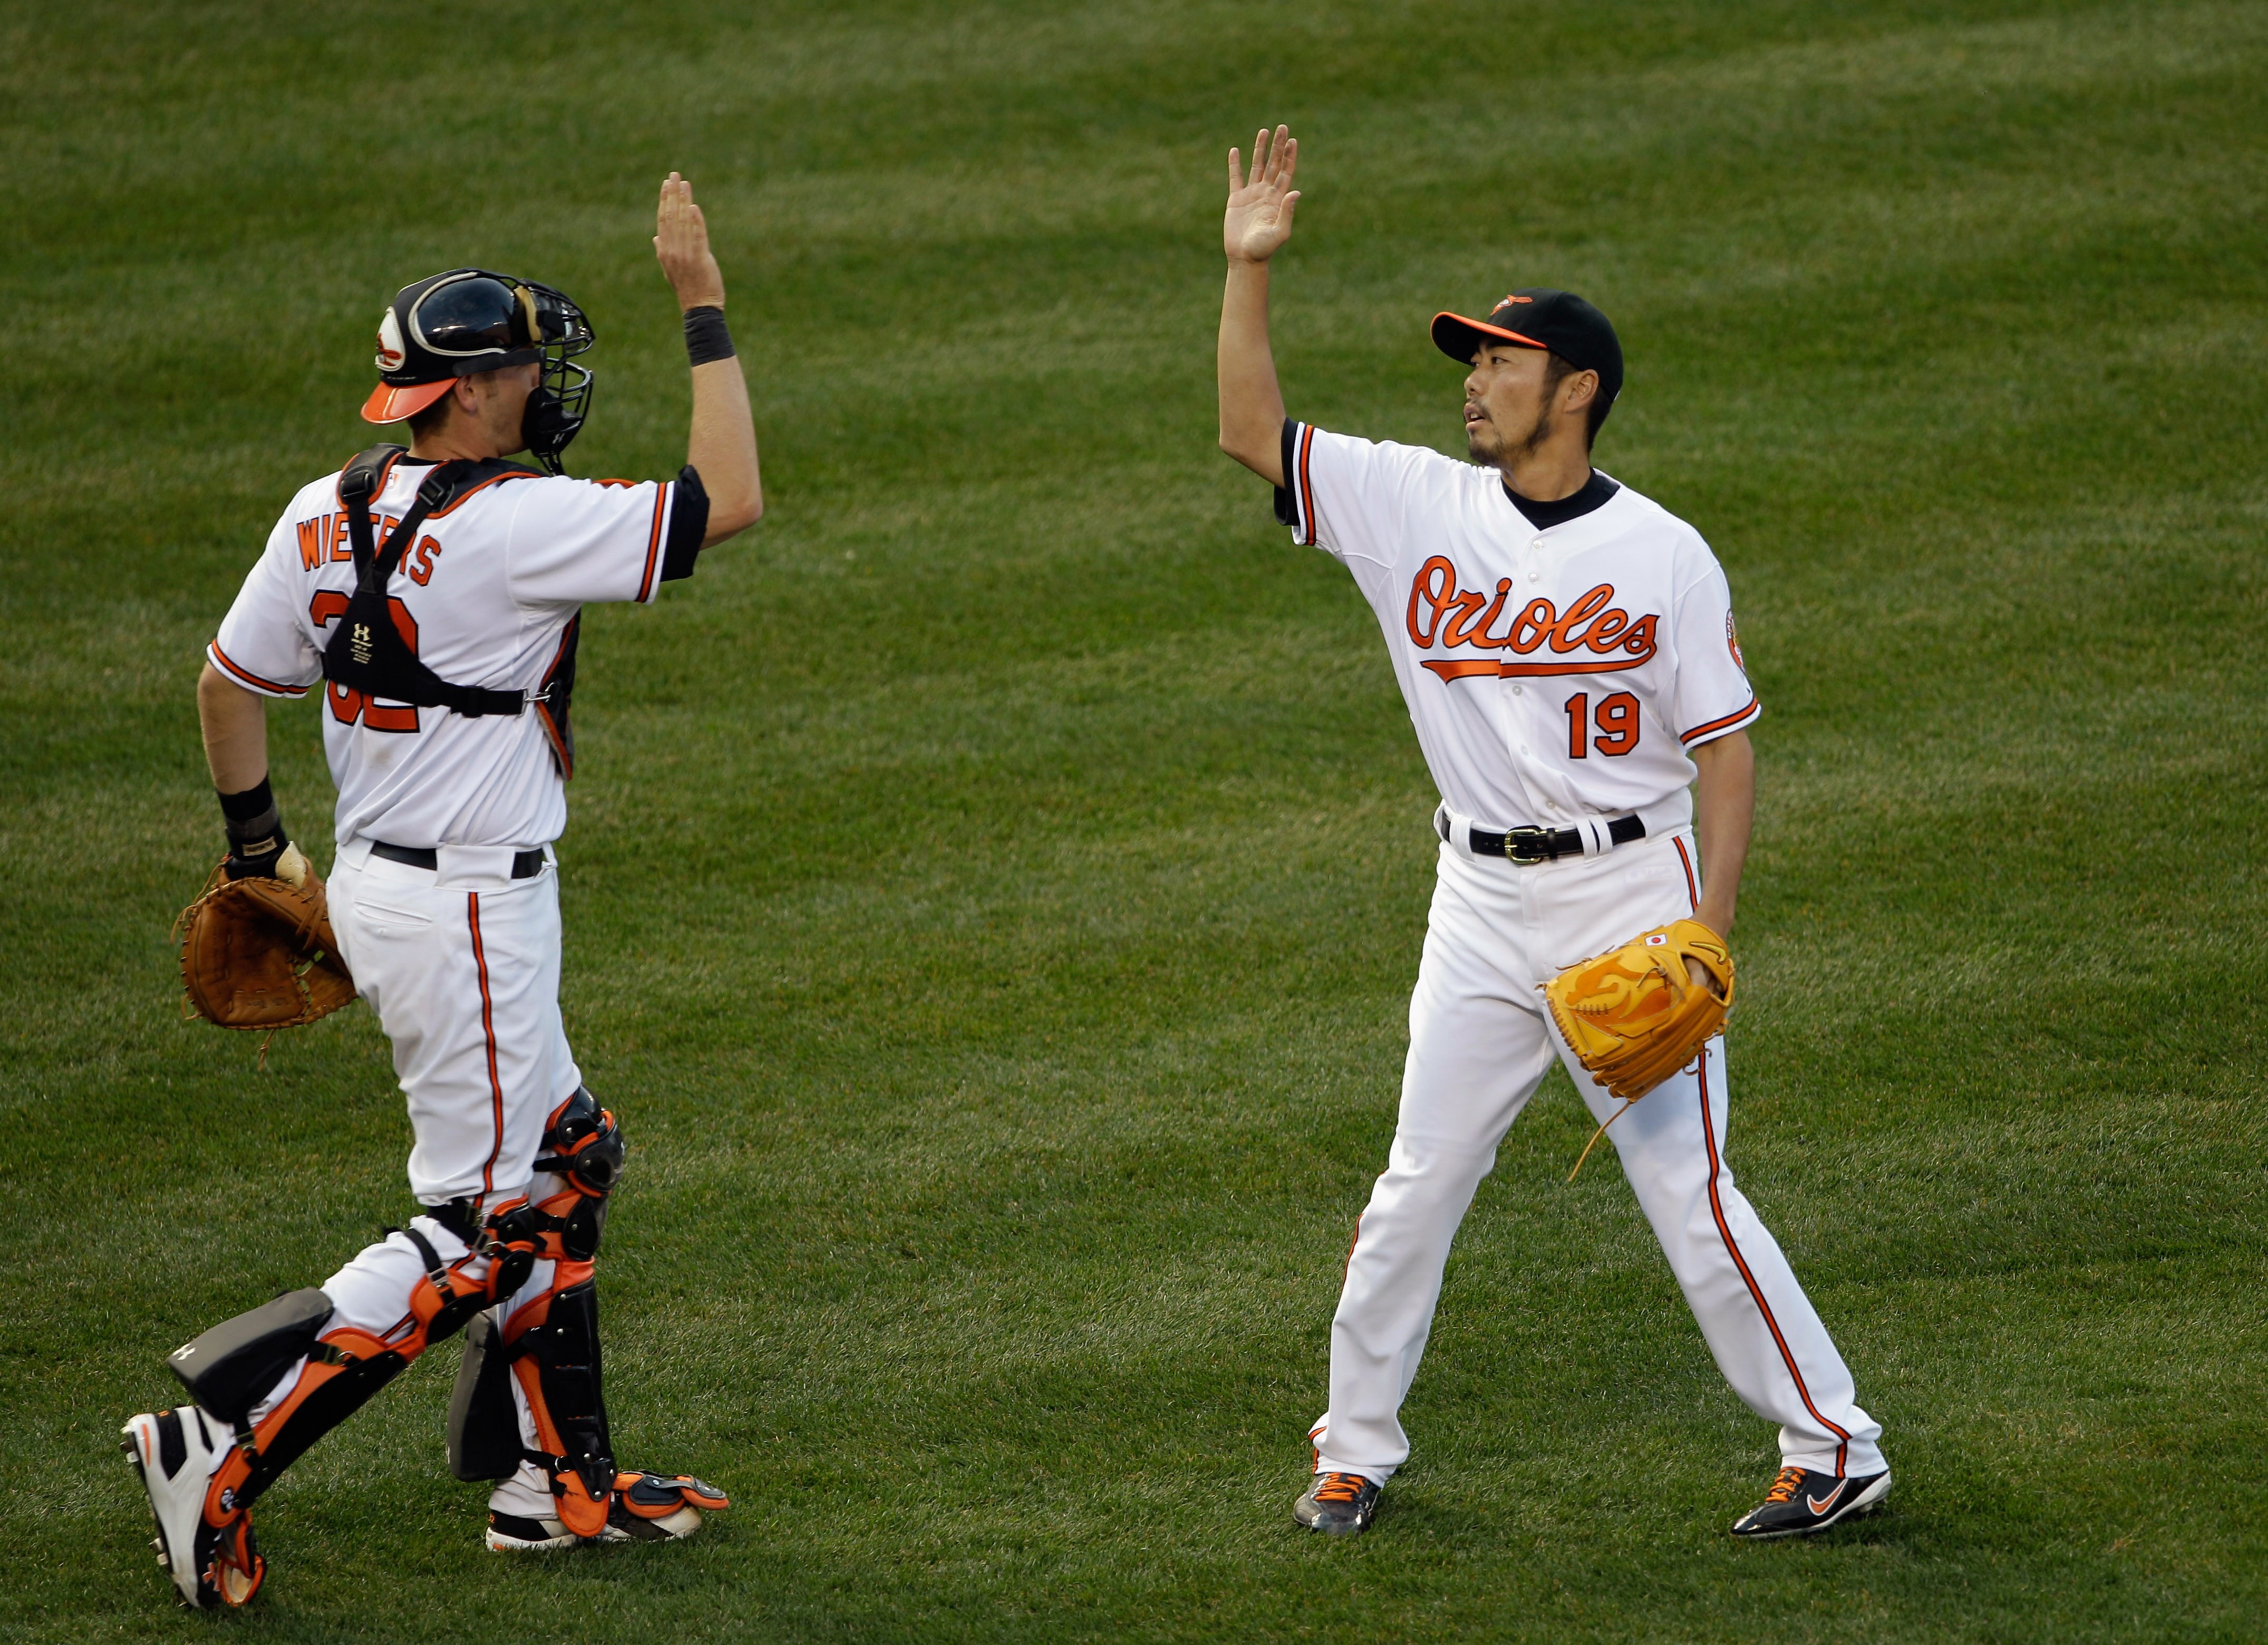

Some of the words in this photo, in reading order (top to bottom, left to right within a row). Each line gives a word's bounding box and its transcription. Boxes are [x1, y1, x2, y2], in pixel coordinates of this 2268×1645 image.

[296, 511, 442, 586] WIEES
[1407, 555, 1660, 655] Orioles
[1565, 691, 1640, 759] 19
